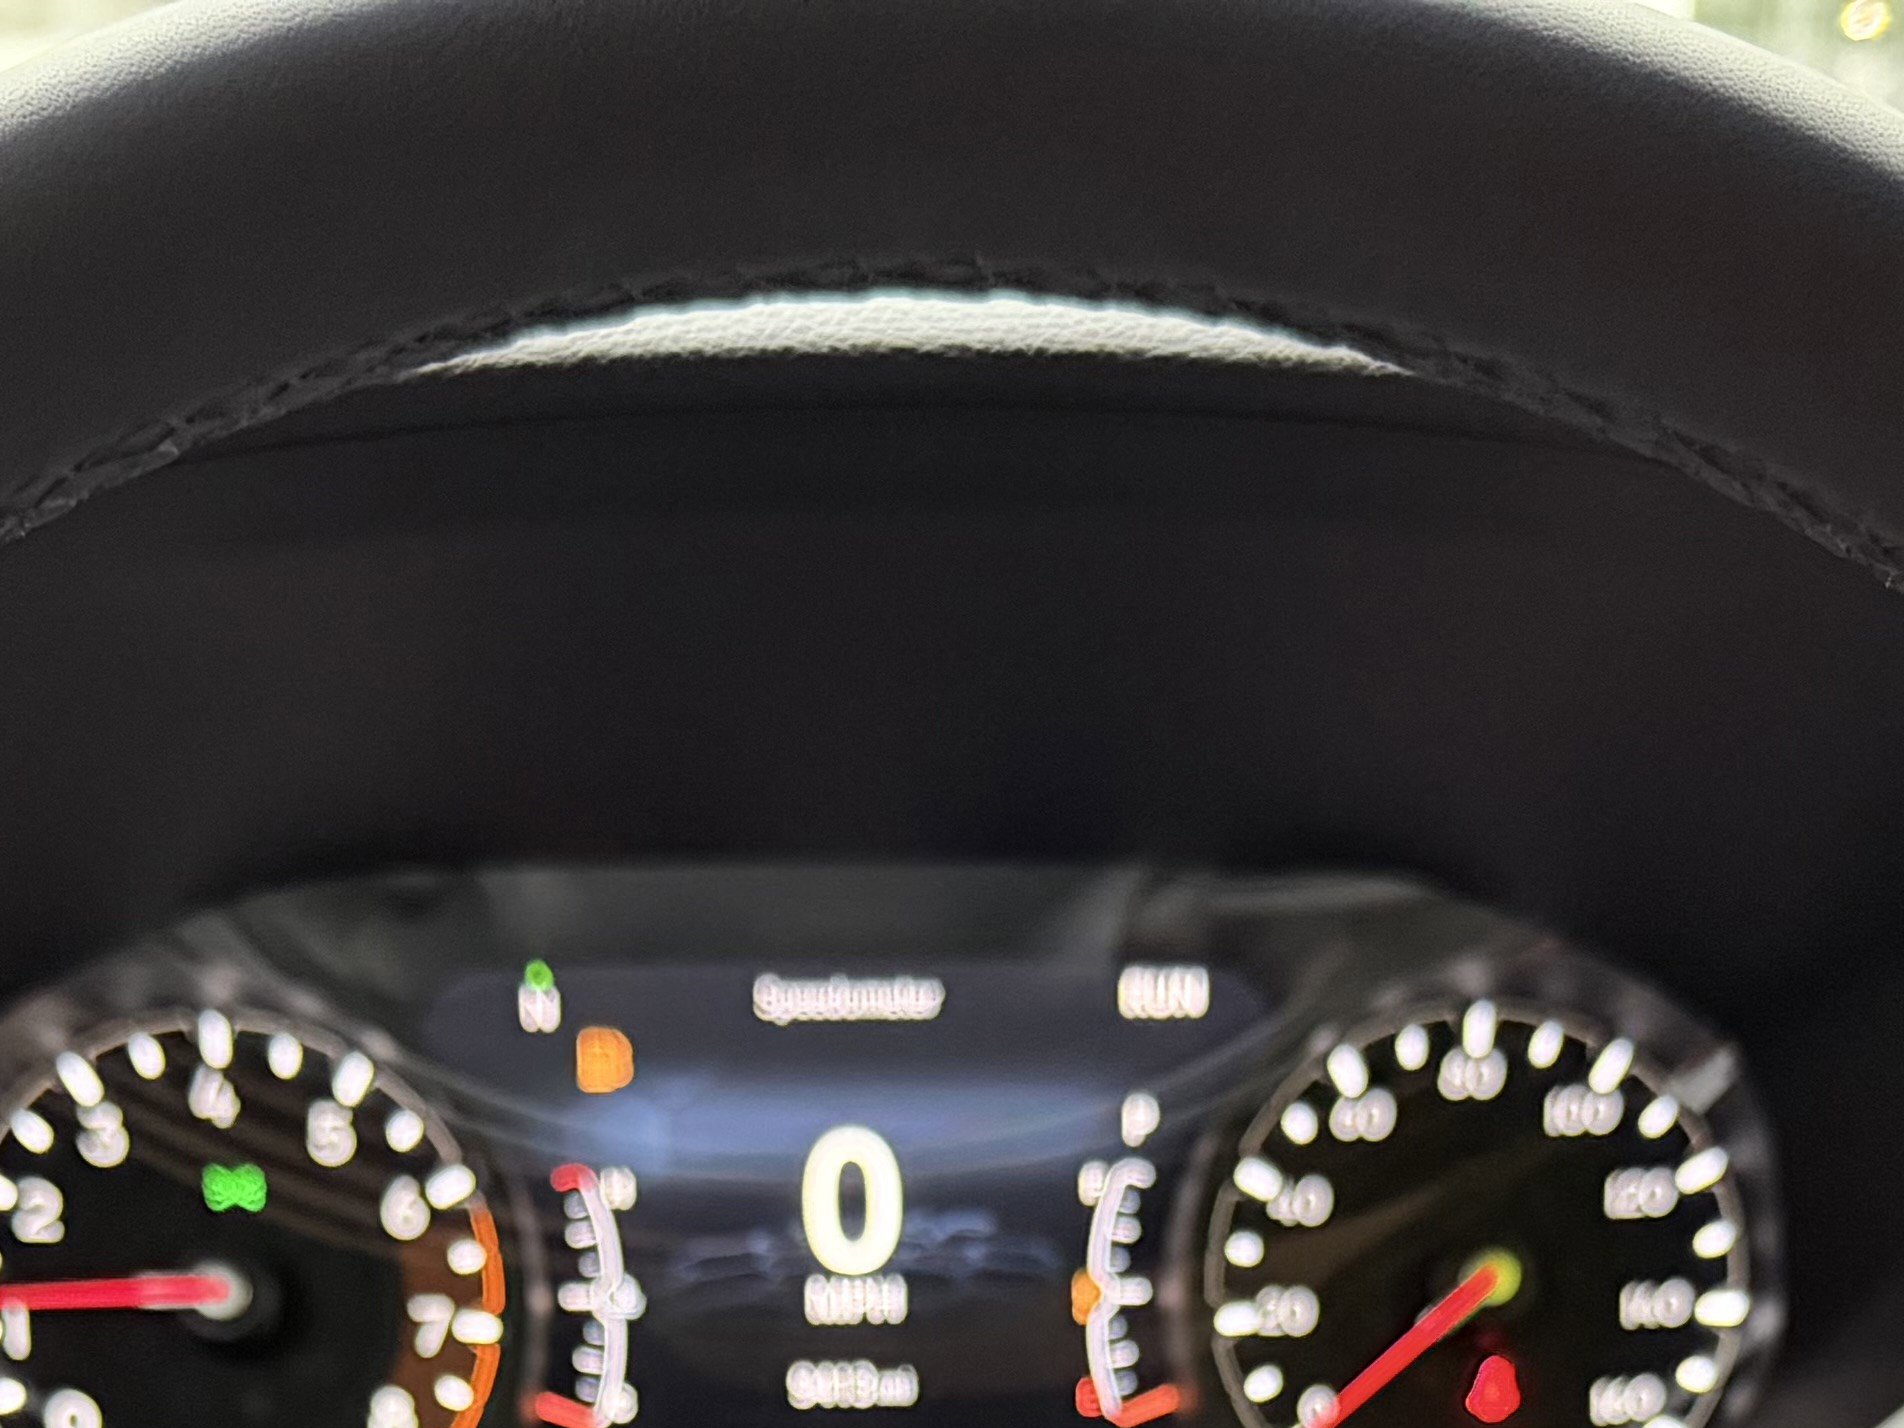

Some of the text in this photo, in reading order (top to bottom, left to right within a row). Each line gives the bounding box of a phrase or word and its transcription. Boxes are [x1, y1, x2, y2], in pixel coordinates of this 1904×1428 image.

[188, 1063, 241, 1129] 4
[1437, 1044, 1508, 1101] 80
[76, 1100, 130, 1168] 3
[306, 1099, 358, 1167] 5
[1329, 1086, 1398, 1142] 60
[1543, 1084, 1625, 1138] 100
[11, 1176, 65, 1245] 2
[380, 1174, 432, 1241] 6
[802, 1125, 903, 1275] 0
[1264, 1173, 1335, 1227] 40
[1604, 1164, 1679, 1221] 120
[1, 1297, 32, 1361] 1
[407, 1294, 455, 1359] 7
[1256, 1285, 1320, 1338] 20
